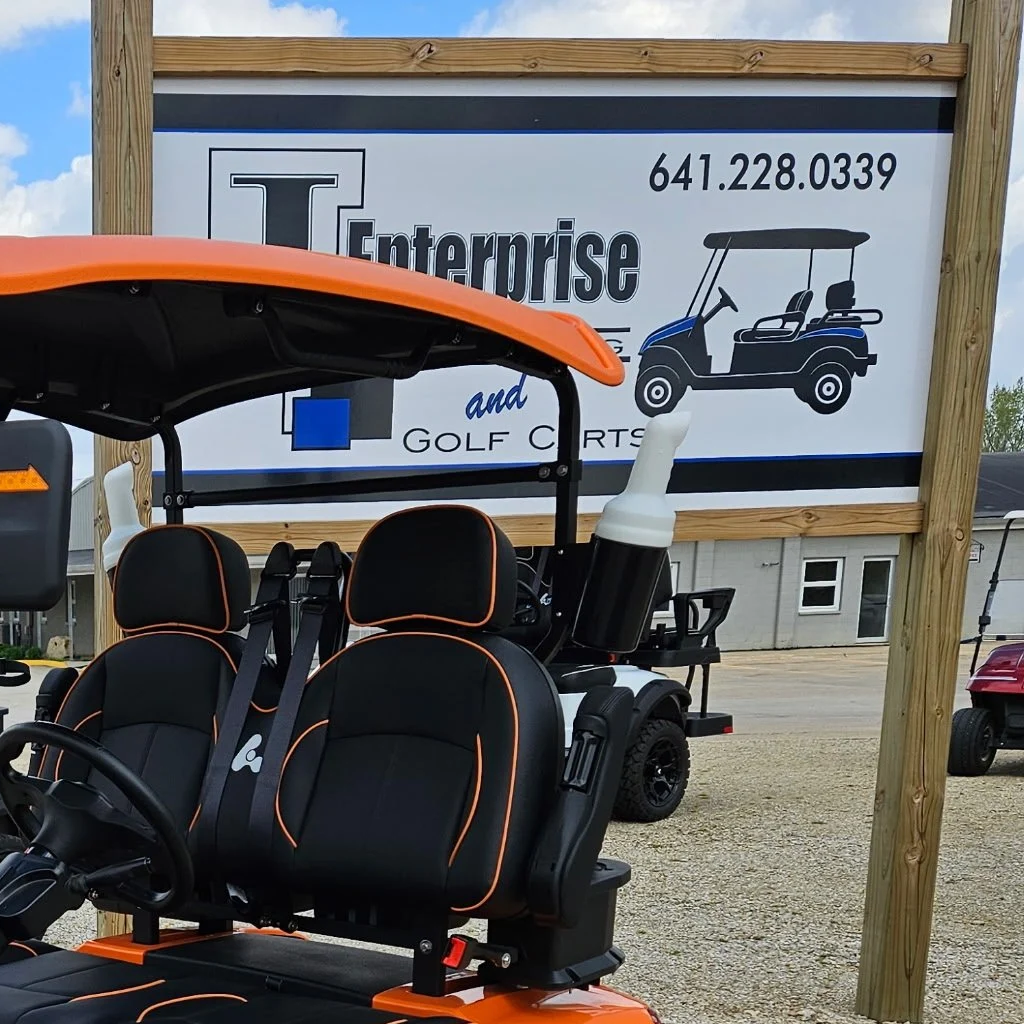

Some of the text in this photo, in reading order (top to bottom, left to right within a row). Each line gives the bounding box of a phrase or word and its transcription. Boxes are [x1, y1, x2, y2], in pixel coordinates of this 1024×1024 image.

[649, 152, 898, 192] 641.228.0339
[347, 218, 641, 303] Enterprise
[465, 373, 528, 420] and
[528, 425, 646, 450] CRTS
